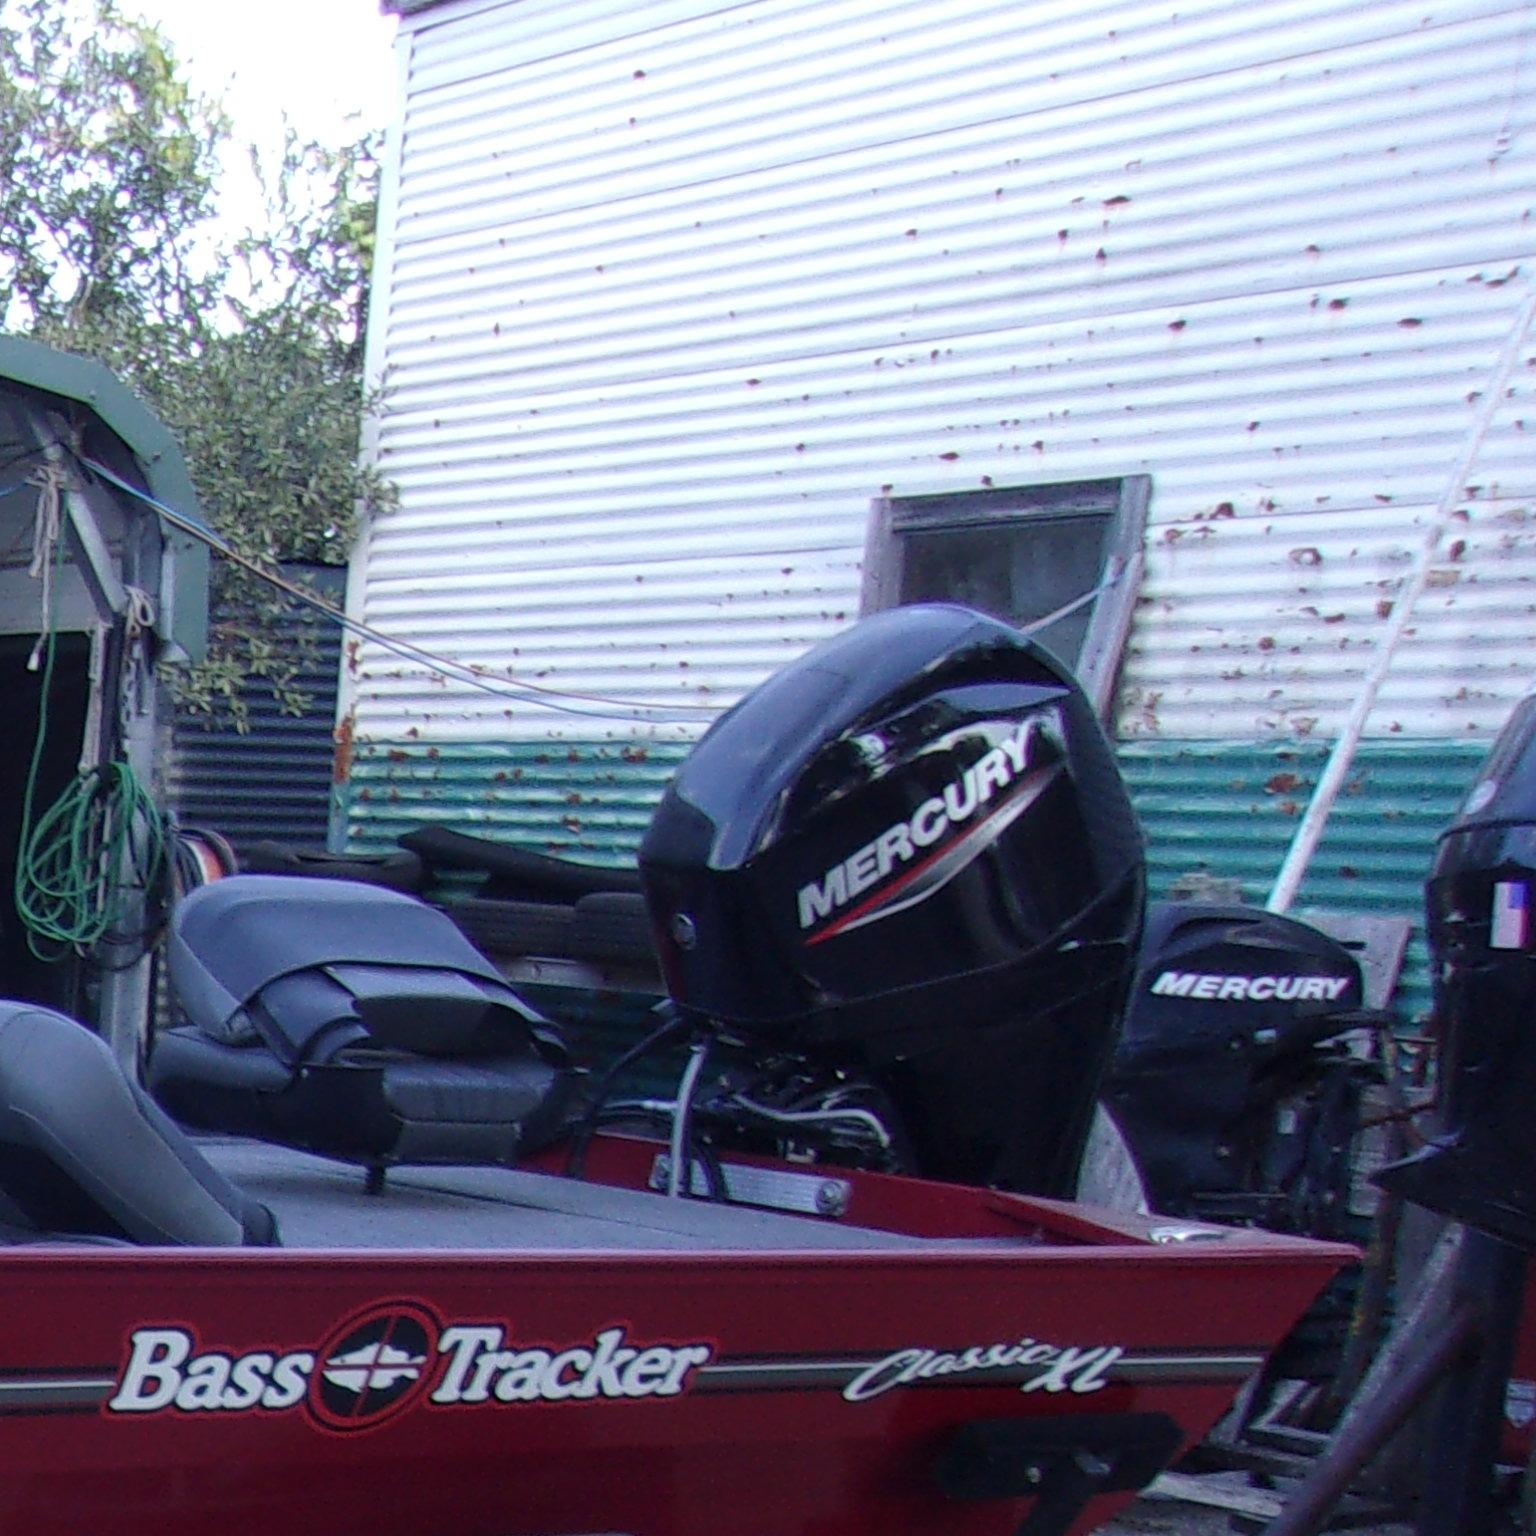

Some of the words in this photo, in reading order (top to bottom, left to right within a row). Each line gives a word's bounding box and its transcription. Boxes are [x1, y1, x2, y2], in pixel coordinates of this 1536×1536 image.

[797, 715, 1036, 929] MERCURY
[1150, 971, 1348, 1001] MERCURY
[109, 1328, 315, 1412] Bass
[430, 1326, 710, 1403] Tracker
[842, 1337, 1059, 1401] Classic
